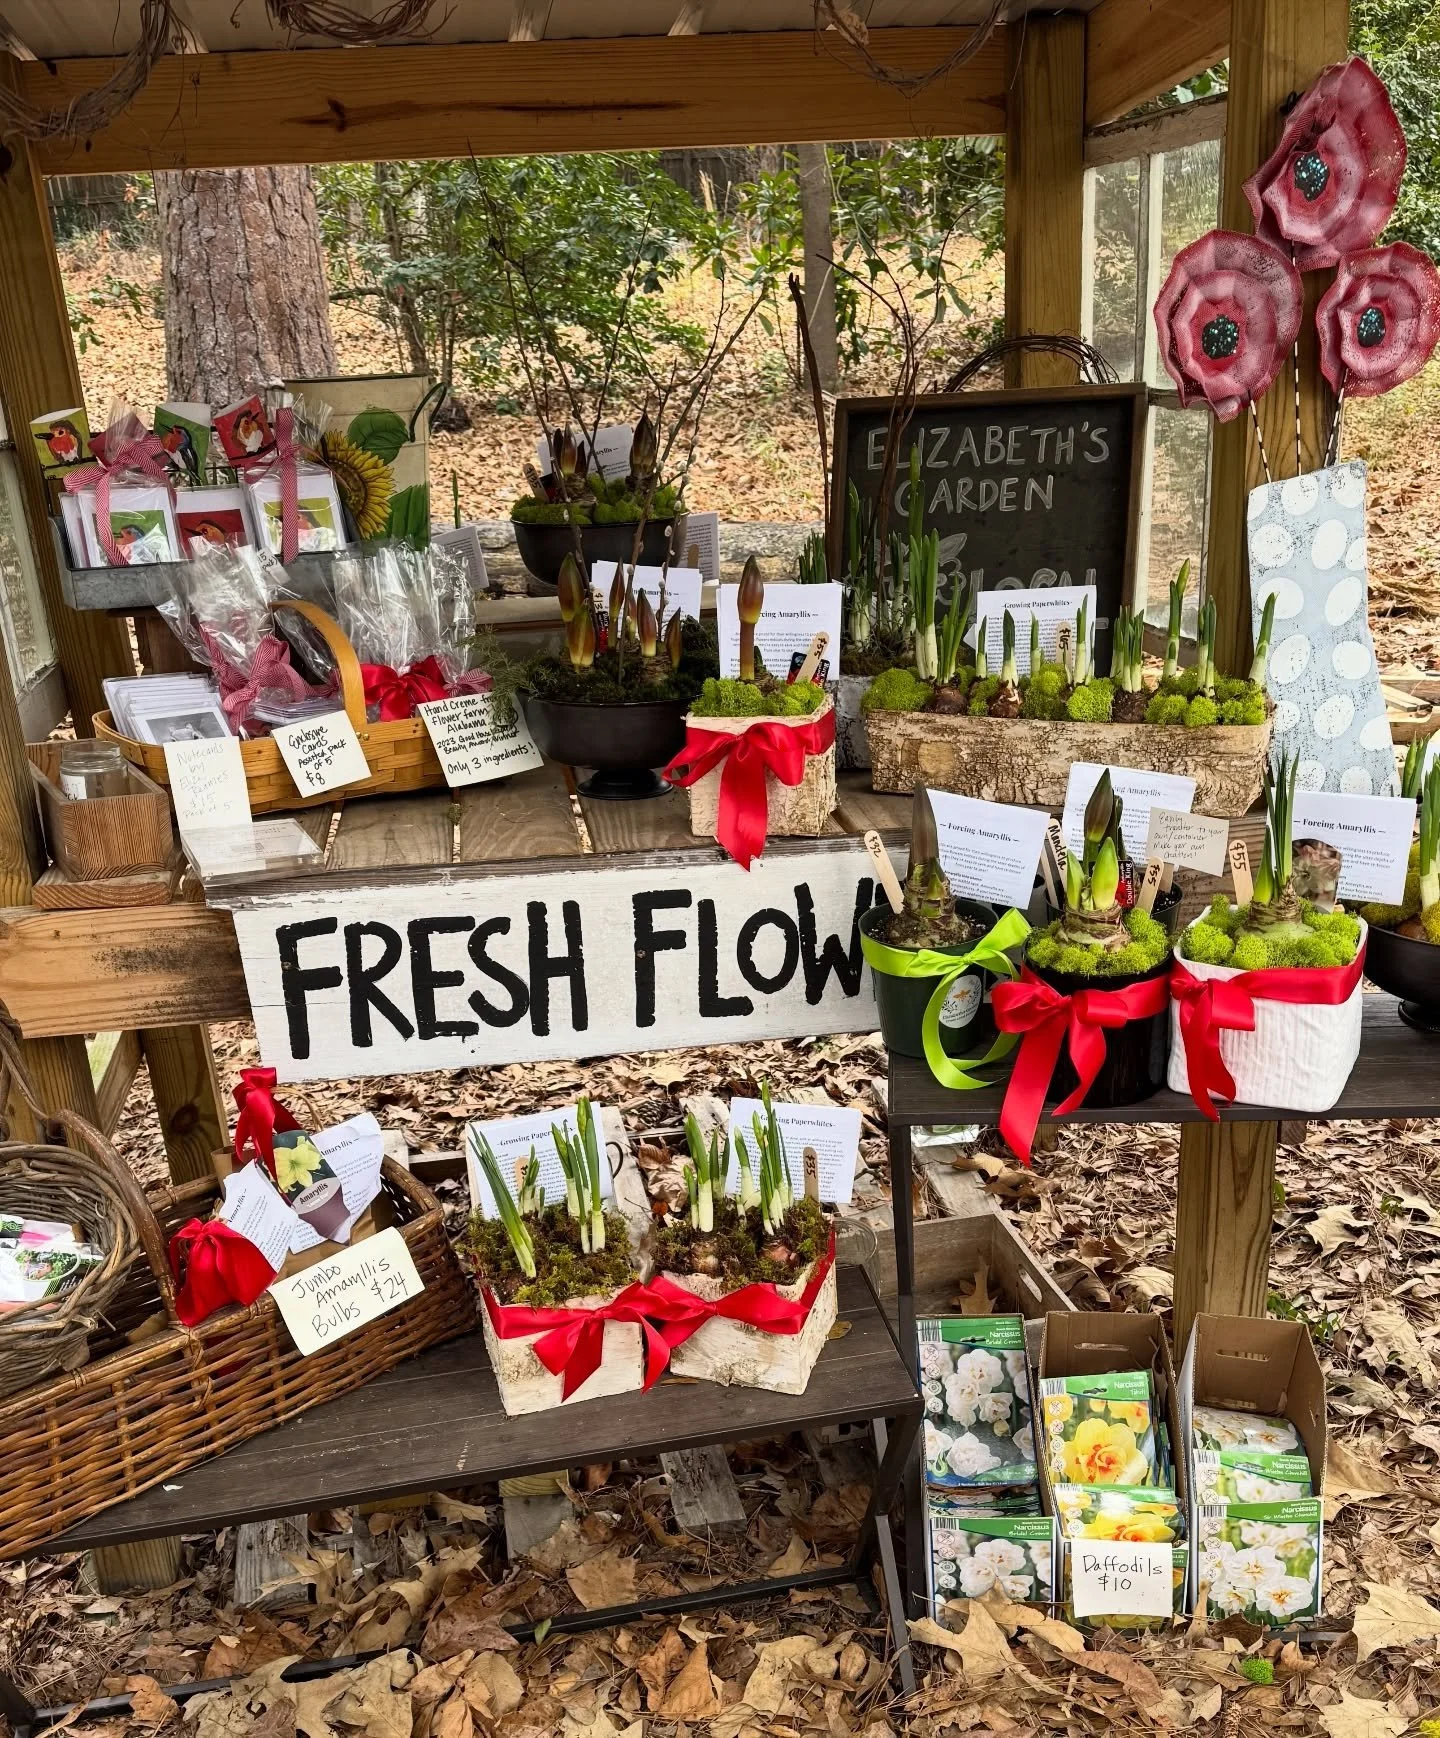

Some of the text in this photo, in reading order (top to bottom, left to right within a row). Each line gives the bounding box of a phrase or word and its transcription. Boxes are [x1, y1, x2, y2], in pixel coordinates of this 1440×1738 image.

[867, 421, 1110, 470] ELIZABETH'S
[760, 611, 811, 619] rcing Amaryllis
[424, 701, 449, 717] Hand
[449, 698, 479, 711] Creme
[447, 719, 487, 734] Alabama
[436, 738, 456, 749] 2023
[313, 755, 333, 770] of 5
[447, 761, 472, 776] Only
[471, 757, 482, 769] 3
[948, 822, 1012, 841] Forcing Amaryllis
[1303, 818, 1376, 834] Forcing Amaryllis
[1230, 841, 1247, 872] $55
[1125, 862, 1133, 904] Double King
[1147, 863, 1161, 887] $55
[276, 877, 886, 1060] FRESH FLOW
[805, 1154, 816, 1179] $35
[299, 1182, 329, 1205] Amaryllis
[291, 1265, 341, 1299] Jumbo
[316, 1257, 390, 1309] Amaryllis
[311, 1271, 409, 1338] Bulbs $24
[1271, 1461, 1307, 1470] Narcissus
[1281, 1505, 1318, 1513] Narcissus
[1082, 1554, 1163, 1577] Daffodils
[1097, 1572, 1132, 1592] $10
